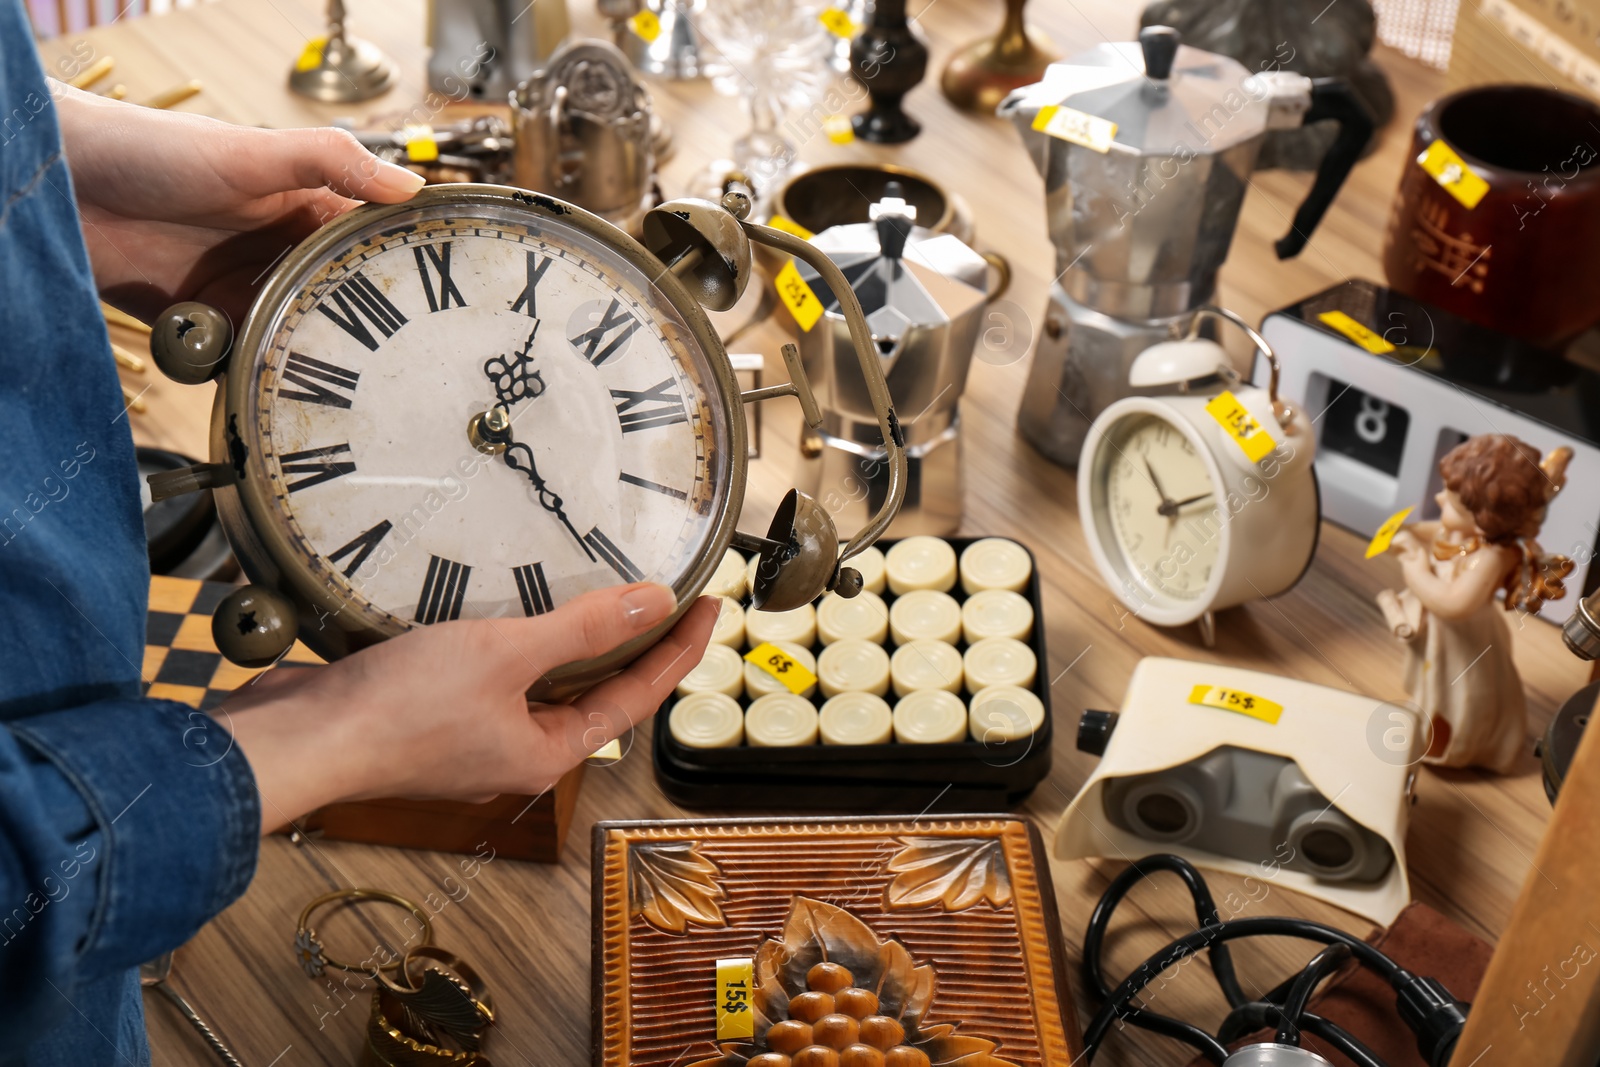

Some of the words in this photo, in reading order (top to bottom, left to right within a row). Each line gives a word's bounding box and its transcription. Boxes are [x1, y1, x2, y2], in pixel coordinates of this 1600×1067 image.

[411, 241, 470, 313] IX
[506, 249, 556, 319] X
[316, 266, 410, 352] VIII
[567, 295, 644, 370] XI
[277, 351, 361, 409] VII
[607, 374, 688, 438] XII
[1226, 409, 1255, 438] 15$
[279, 440, 356, 496] VI
[619, 470, 688, 503] I
[327, 519, 393, 580] V
[583, 525, 647, 583] II
[414, 553, 475, 625] IIII
[510, 561, 555, 617] III
[769, 654, 793, 673] 6$
[1220, 691, 1255, 709] 15$
[722, 980, 748, 1014] 15$
